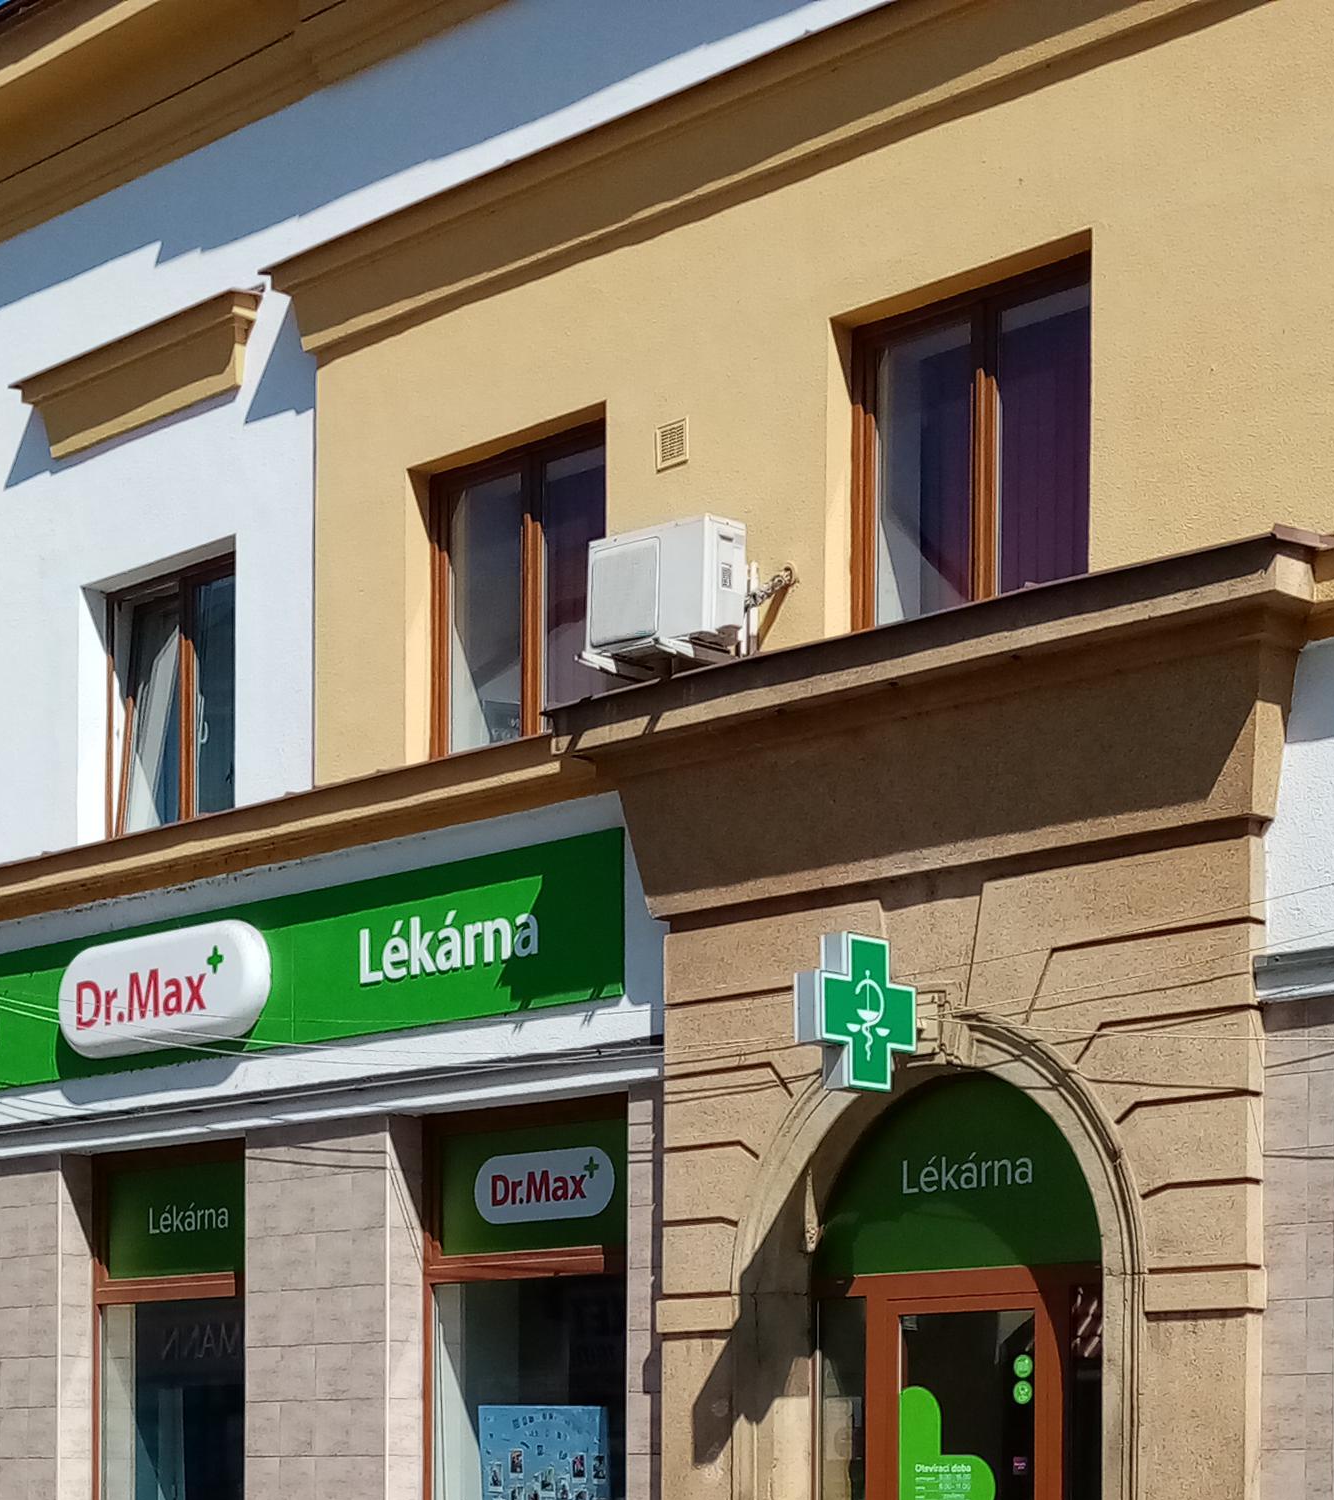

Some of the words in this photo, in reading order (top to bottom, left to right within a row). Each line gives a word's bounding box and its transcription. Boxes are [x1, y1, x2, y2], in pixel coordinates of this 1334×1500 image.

[359, 909, 539, 985] Lékárna
[76, 967, 208, 1031] Dr.Max
[491, 1169, 587, 1207] Dr.Max
[902, 1151, 1034, 1195] Lékárna
[148, 1202, 229, 1235] Lékárna
